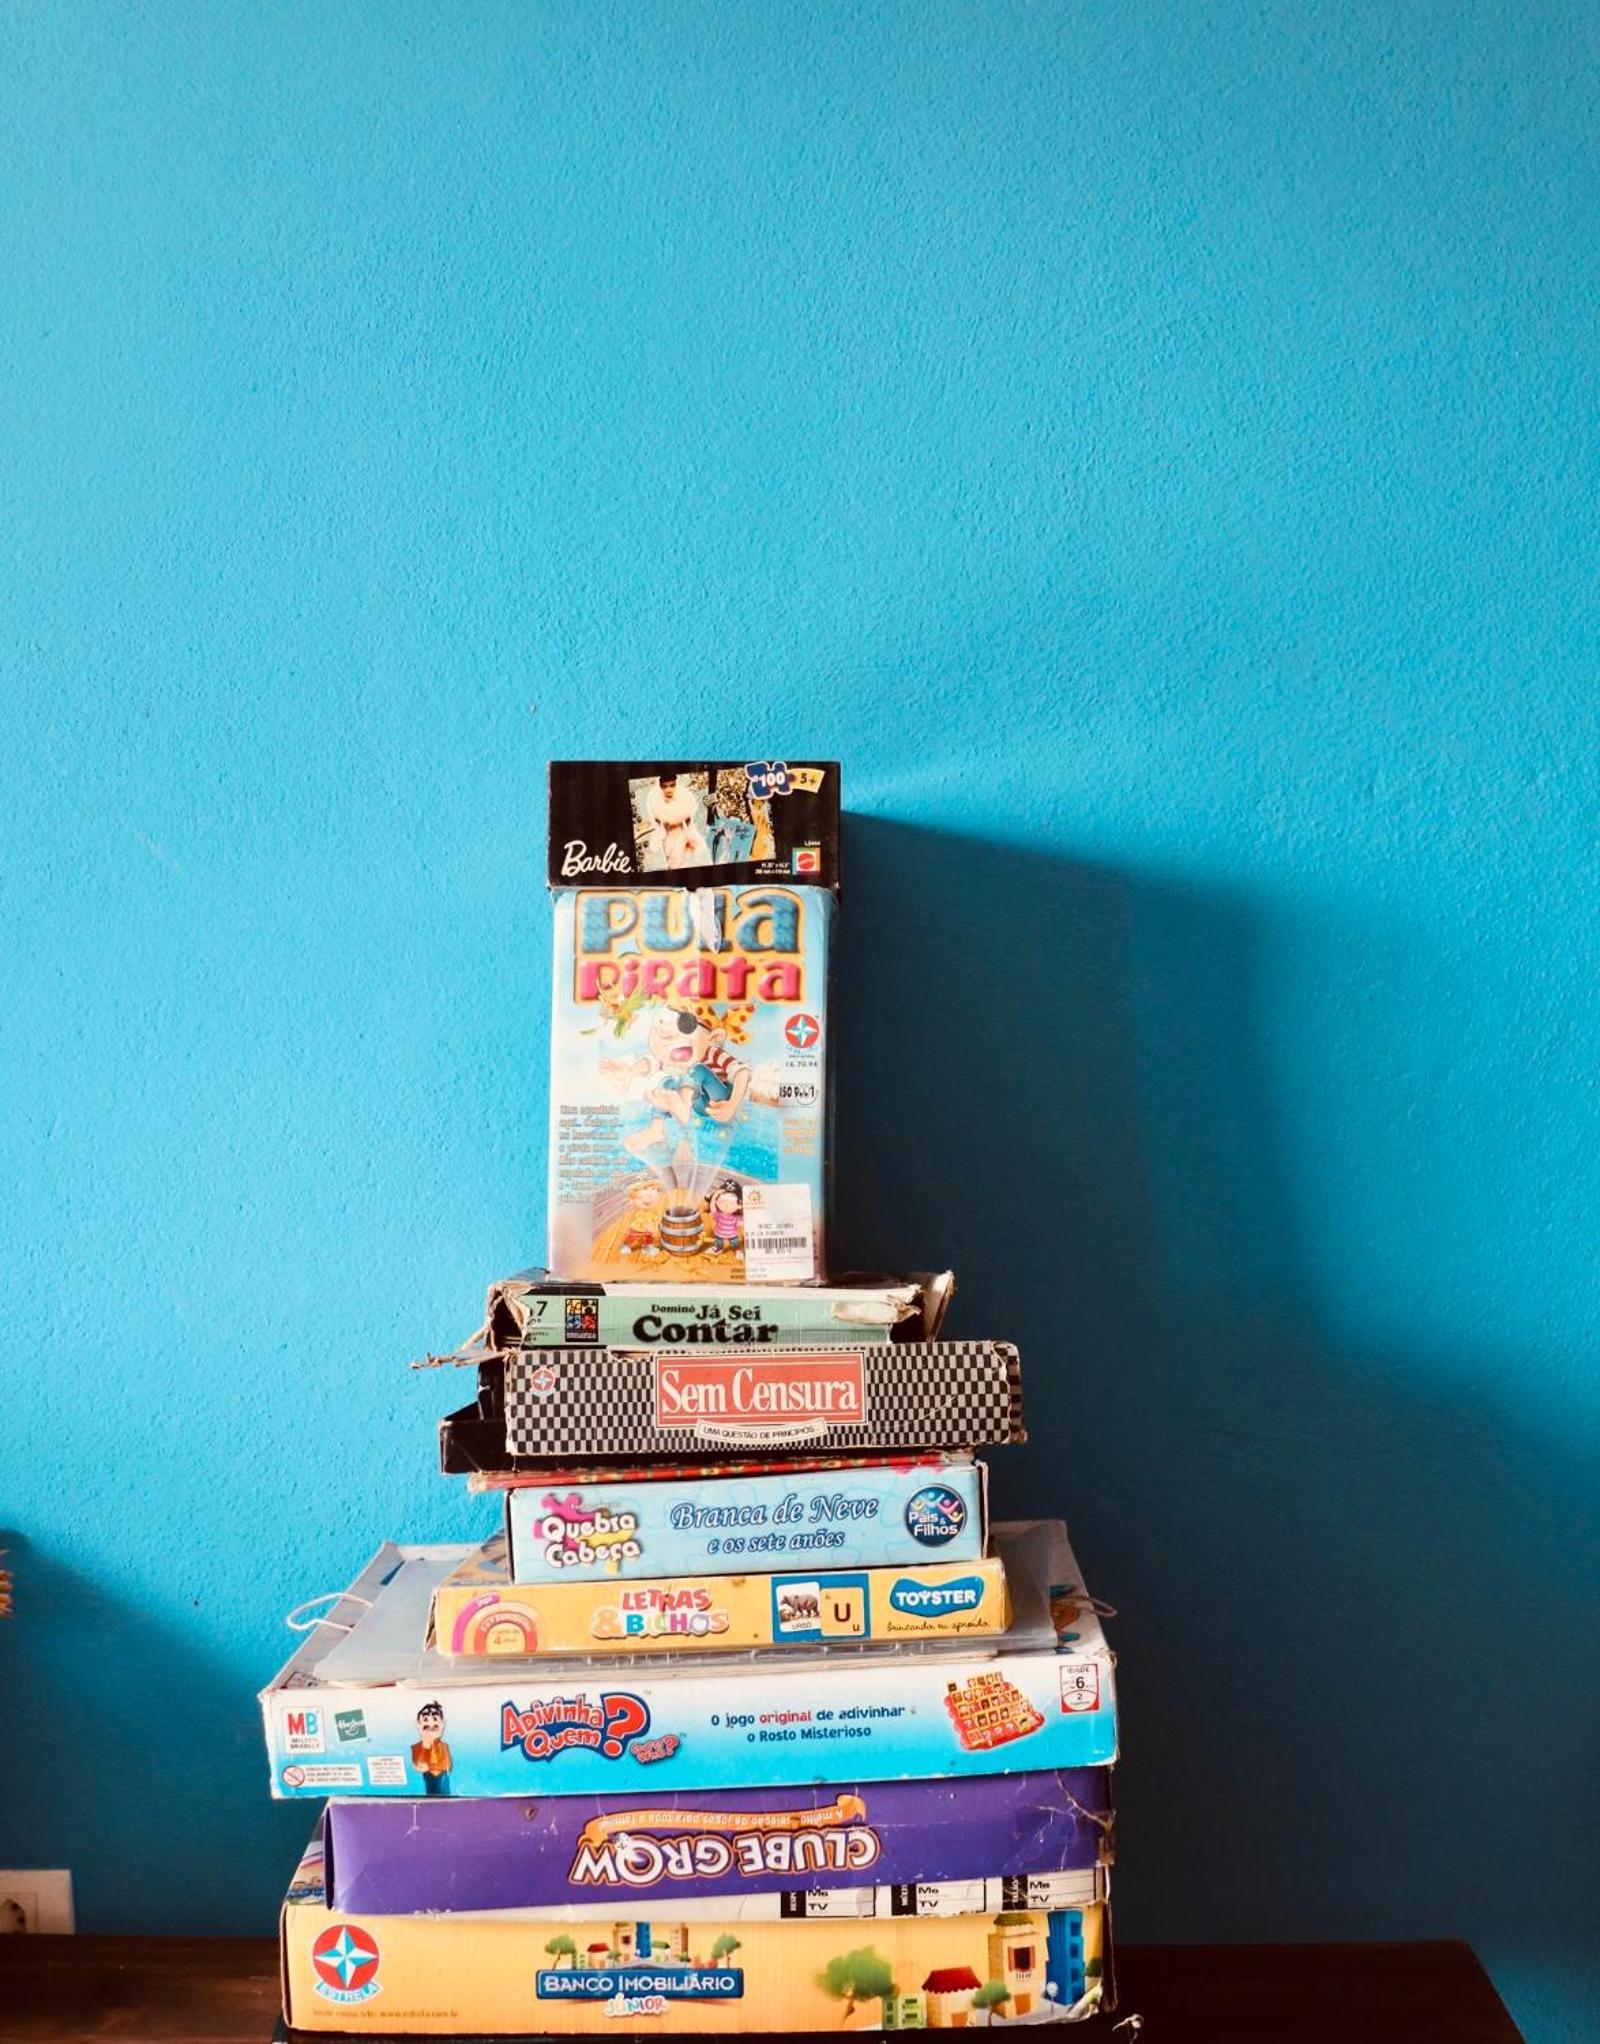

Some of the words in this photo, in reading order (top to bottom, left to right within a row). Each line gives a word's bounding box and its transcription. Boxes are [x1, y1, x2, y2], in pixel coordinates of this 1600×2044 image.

[759, 771, 786, 787] 100
[800, 772, 817, 785] 5+
[561, 839, 632, 877] Barbie
[536, 1300, 549, 1317] 7
[695, 1304, 721, 1320] Já
[728, 1304, 761, 1321] Sei
[632, 1314, 779, 1344] Contar
[661, 1369, 727, 1413] Sem
[731, 1367, 860, 1412] Censura
[703, 1426, 720, 1435] UMA
[759, 1430, 770, 1439] DE
[669, 1502, 766, 1530] Branca
[771, 1492, 803, 1525] de
[808, 1496, 879, 1523] Neve
[908, 1512, 939, 1524] Pais
[541, 1511, 636, 1542] Quebra
[914, 1523, 959, 1537] Filhos
[707, 1538, 718, 1554] e
[721, 1537, 744, 1553] os
[748, 1533, 785, 1552] sete
[789, 1528, 845, 1549] anões
[545, 1540, 640, 1568] Cabeça
[622, 1588, 712, 1612] LETRAS
[895, 1589, 977, 1607] TOYSTER
[833, 1603, 851, 1622] U
[1075, 1676, 1086, 1689] 6
[287, 1711, 319, 1736] MB
[725, 1712, 755, 1728] jogo
[758, 1709, 813, 1726] original
[816, 1708, 834, 1721] de
[838, 1705, 906, 1720] adivinhar
[759, 1729, 797, 1742] Rosto
[800, 1725, 872, 1741] Misterioso
[572, 1834, 731, 1884] GROW
[741, 1830, 877, 1874] CLUBE
[809, 1903, 828, 1911] TV
[918, 1900, 939, 1908] TV
[1030, 1895, 1050, 1903] TV
[544, 1974, 613, 1993] BANCO
[618, 1972, 736, 1993] IMOBILIÁRIO
